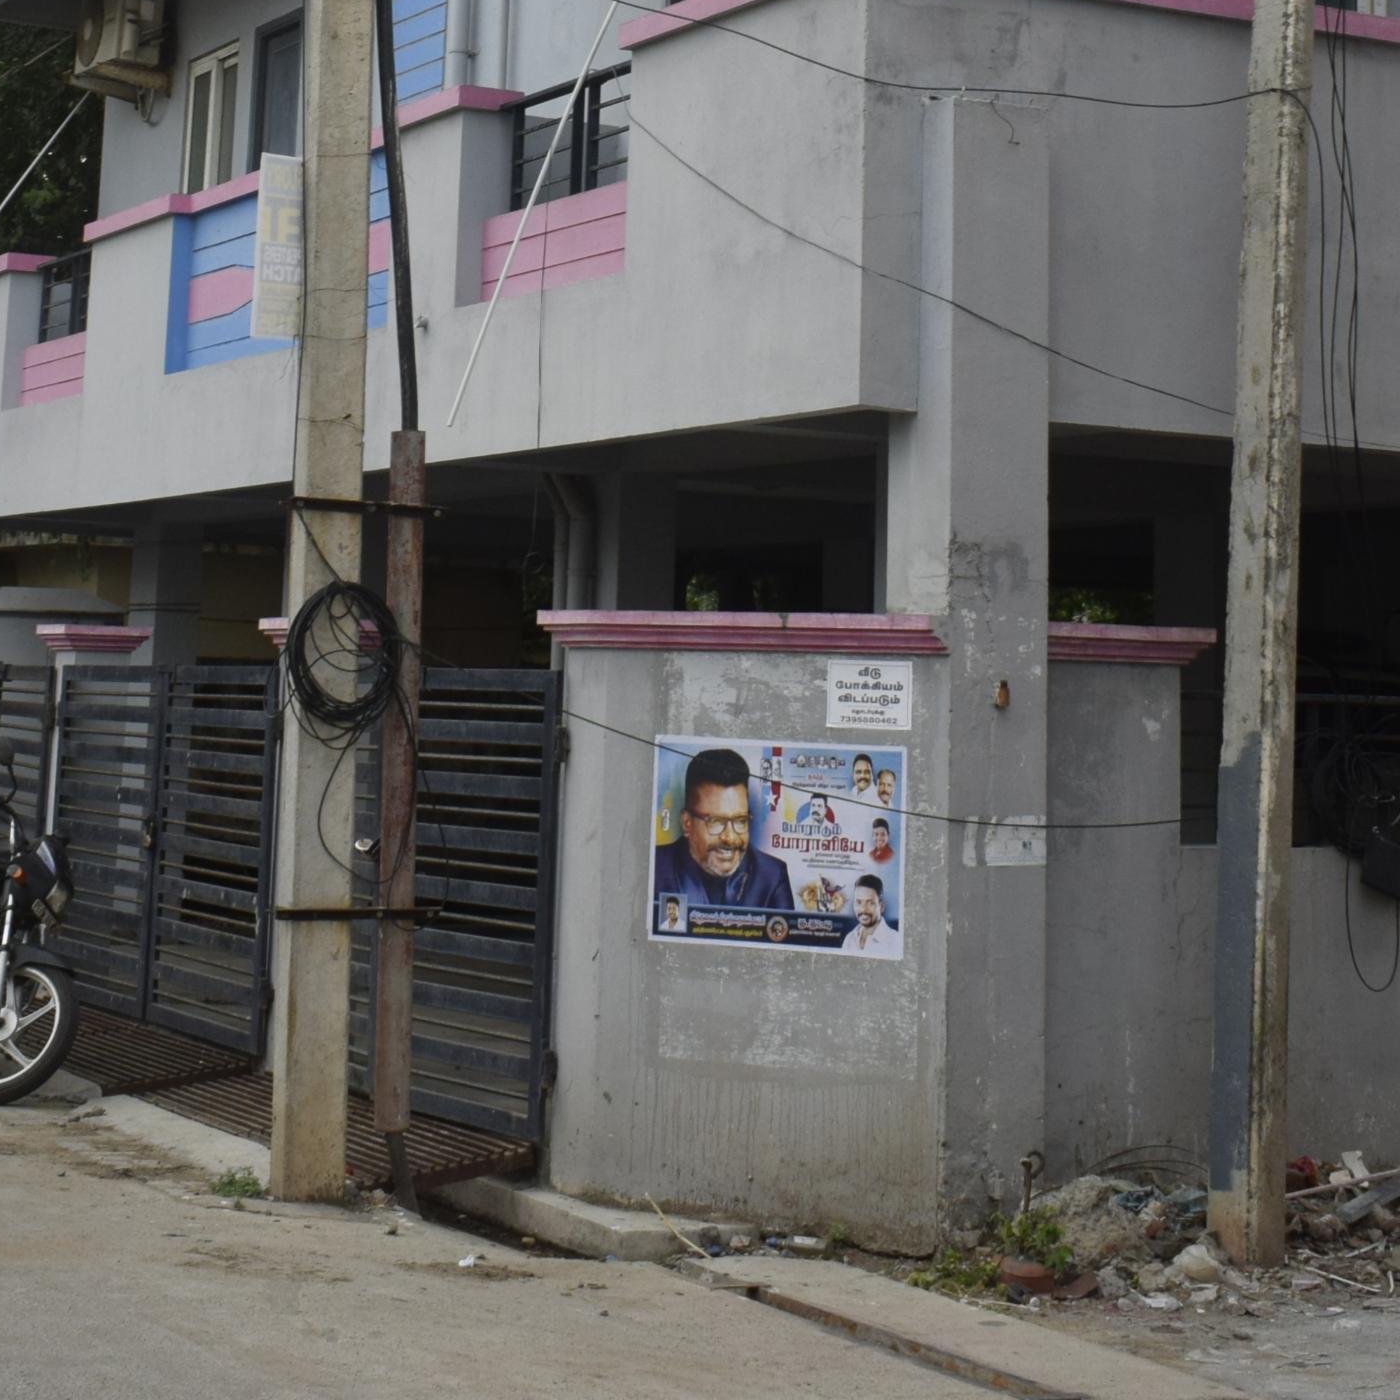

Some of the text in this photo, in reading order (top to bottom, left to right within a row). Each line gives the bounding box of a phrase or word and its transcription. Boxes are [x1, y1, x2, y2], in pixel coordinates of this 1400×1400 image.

[858, 666, 881, 679] வீடு
[835, 680, 903, 691] போக்கியம்
[838, 693, 900, 706] விடப்படும்
[782, 822, 842, 837] போராடும்
[772, 834, 865, 853] போராளியே
